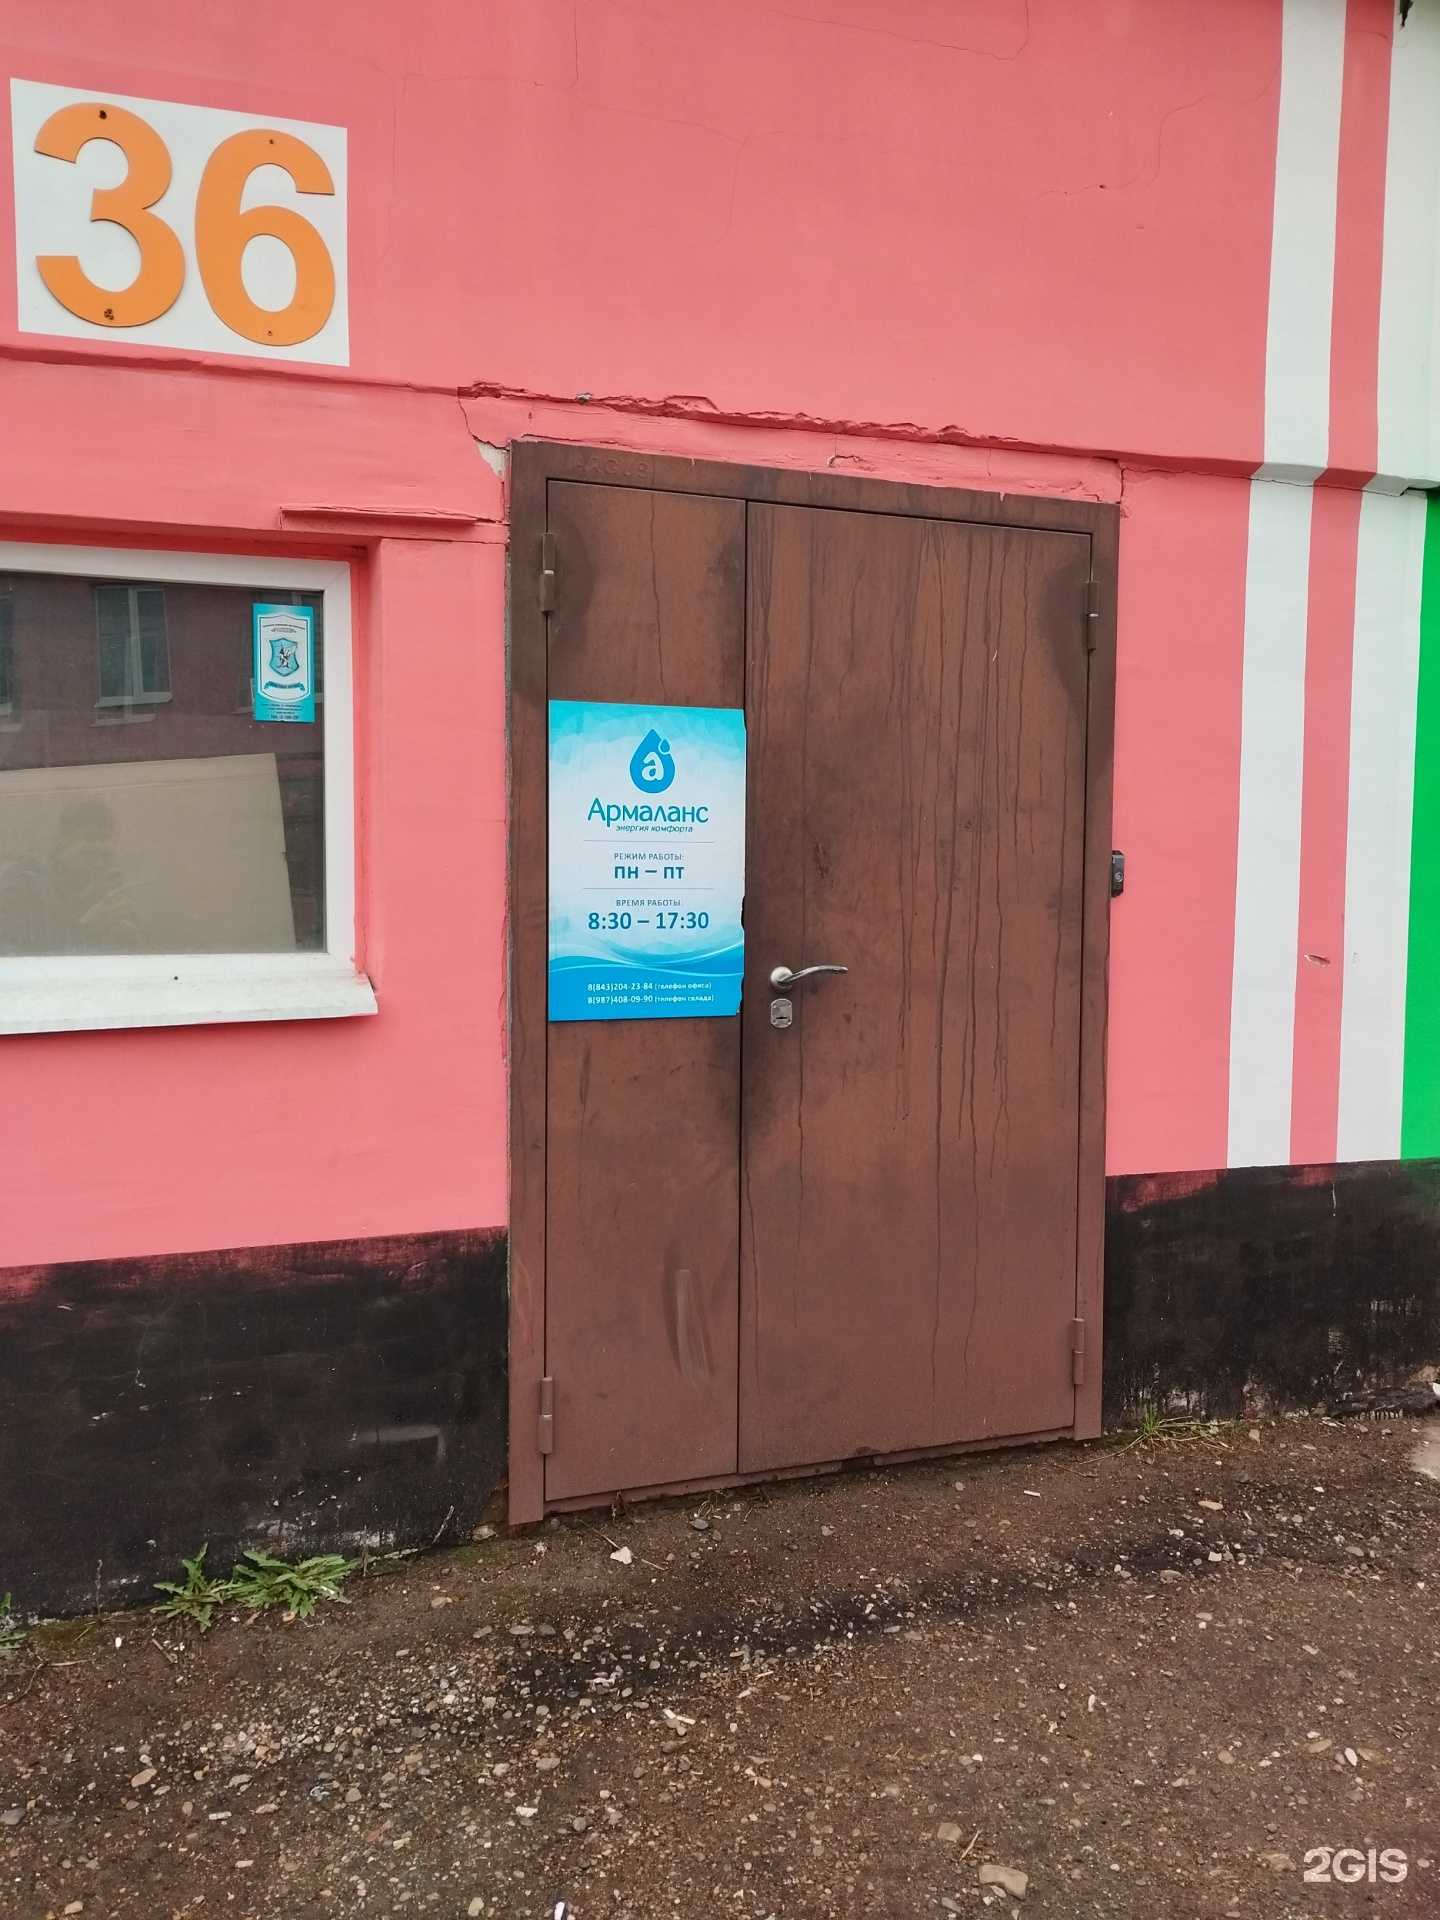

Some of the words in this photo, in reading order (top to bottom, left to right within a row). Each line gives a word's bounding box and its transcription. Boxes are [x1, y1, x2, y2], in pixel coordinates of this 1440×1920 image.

[34, 102, 336, 346] 36
[587, 798, 709, 827] Армаланс
[615, 824, 649, 832] энергия
[651, 825, 693, 833] комфорта
[614, 852, 646, 860] РЕЖИМ
[588, 912, 632, 930] 8:30
[656, 912, 709, 930] 17:30
